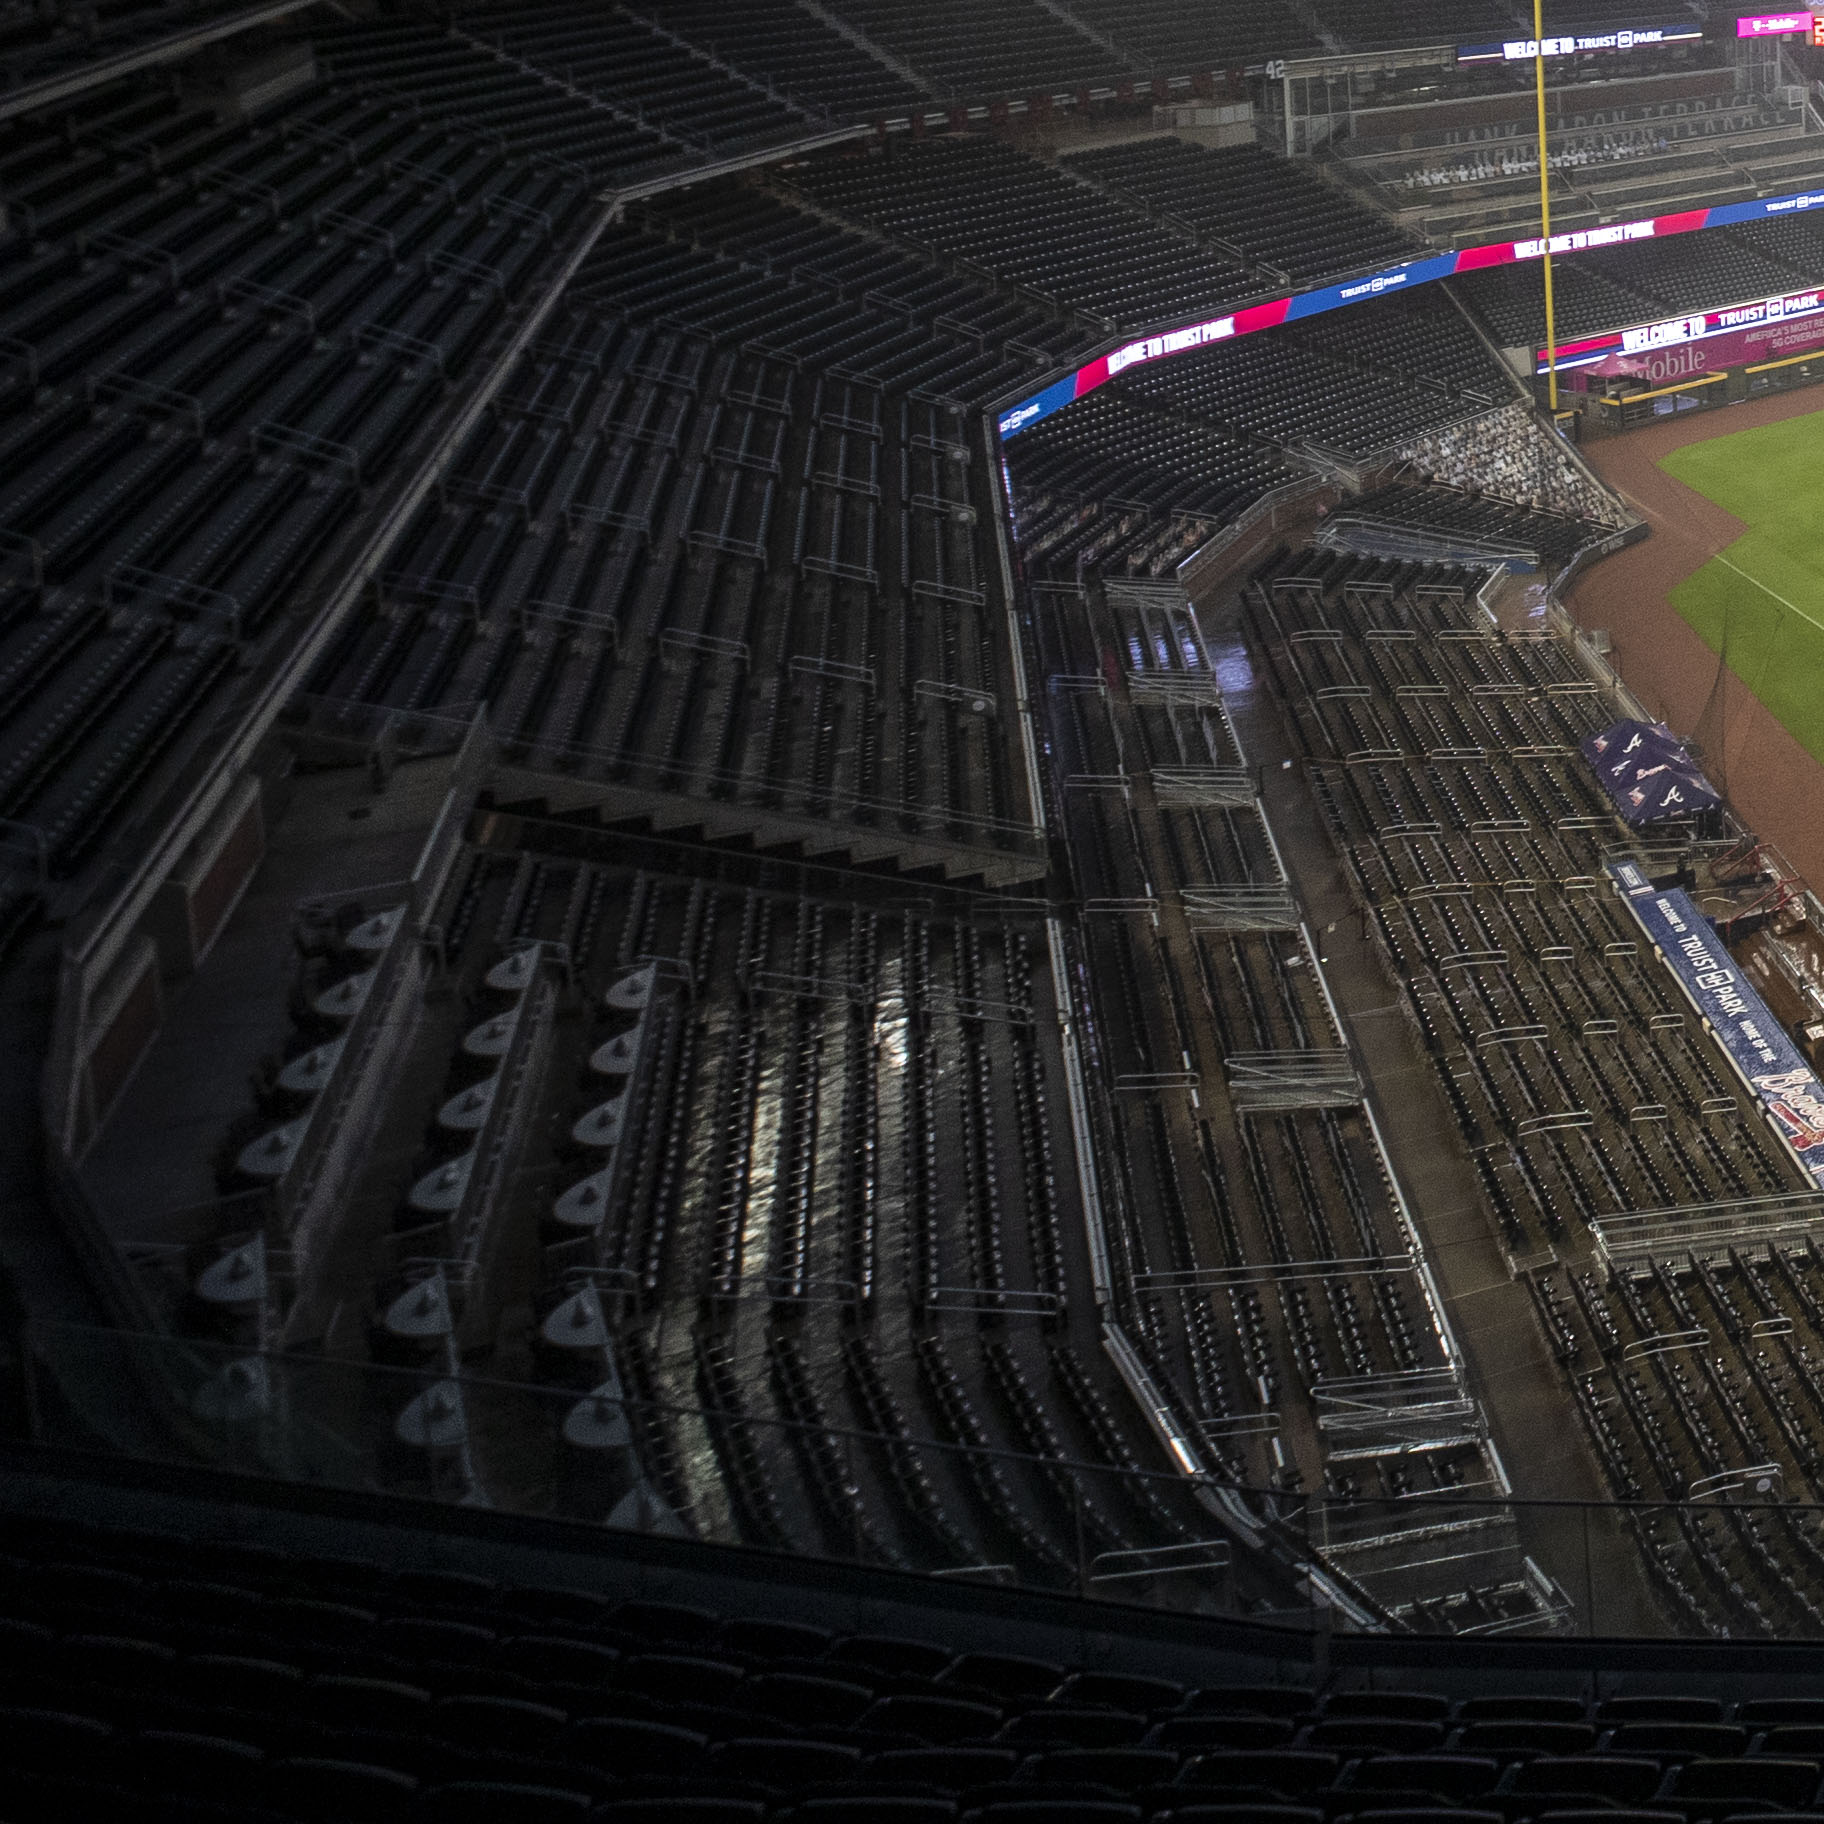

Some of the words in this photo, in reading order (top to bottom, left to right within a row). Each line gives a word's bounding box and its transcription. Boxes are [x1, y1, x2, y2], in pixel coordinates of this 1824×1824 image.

[1577, 36, 1616, 49] TRUIST
[1633, 31, 1662, 44] PARK
[1265, 60, 1285, 79] 42
[1340, 282, 1371, 299] TRUIST
[1621, 319, 1689, 352] WELCOME
[1687, 315, 1706, 336] TO
[1717, 304, 1766, 327] TRUIST
[1784, 293, 1820, 313] PARK
[1655, 898, 1681, 926] WELCOME
[1675, 922, 1687, 933] TO
[1678, 934, 1719, 973] TRUIST
[1711, 984, 1748, 1018] PARK
[1739, 1019, 1756, 1040] HOME
[1751, 1037, 1765, 1050] OF
[1759, 1047, 1777, 1064] THE
